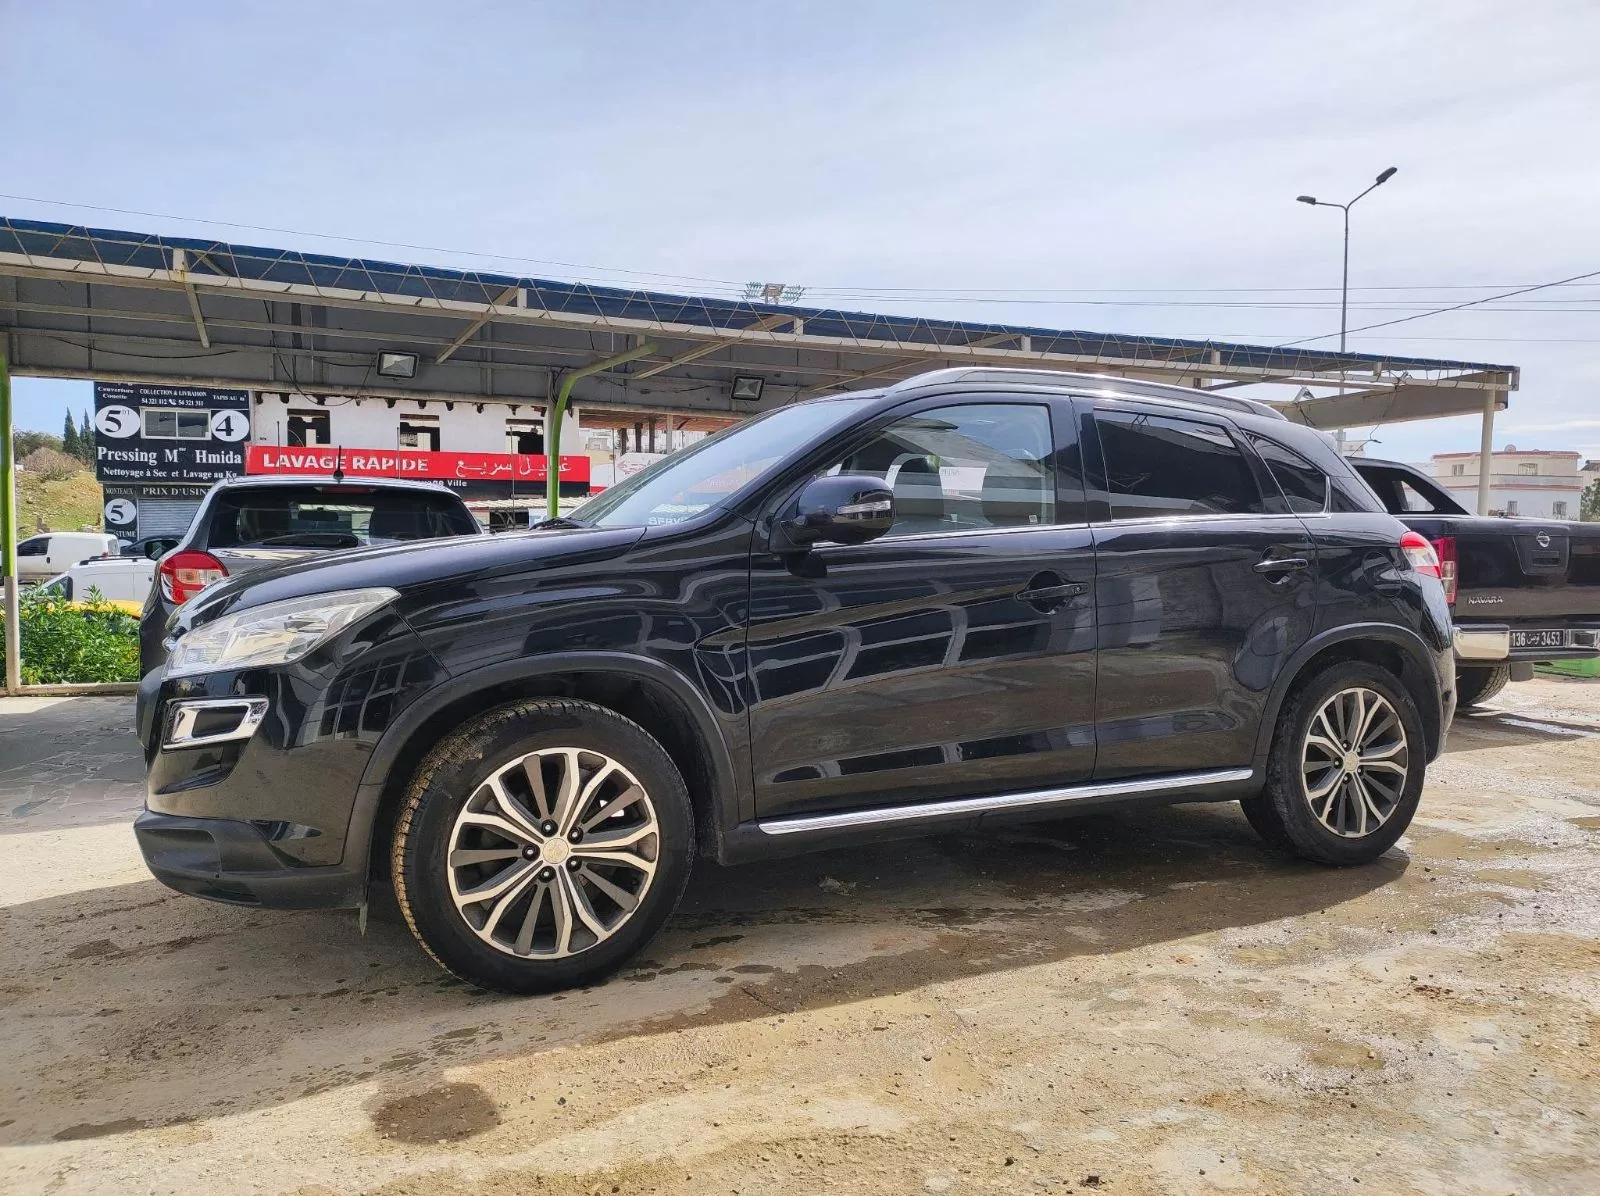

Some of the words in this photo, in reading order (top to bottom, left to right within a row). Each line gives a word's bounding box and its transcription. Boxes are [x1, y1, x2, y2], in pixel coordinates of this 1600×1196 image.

[140, 388, 173, 396] COLLECTION
[97, 446, 158, 465] Pressing
[195, 449, 242, 464] Hmida
[263, 453, 347, 469] LAVAGE
[352, 456, 429, 472] RAPIDE
[103, 467, 144, 478] Nettoyage
[145, 467, 151, 477] à
[153, 469, 167, 478] Sec
[171, 470, 179, 478] et
[183, 469, 211, 480] Lavage
[213, 471, 224, 479] au
[447, 479, 468, 487] Ville
[143, 487, 168, 495] PRIX
[171, 487, 210, 496] D'USIN
[115, 530, 136, 538] STUME
[1468, 596, 1504, 604] NAVARA
[1512, 632, 1526, 647] 136
[1541, 631, 1560, 646] 3453
